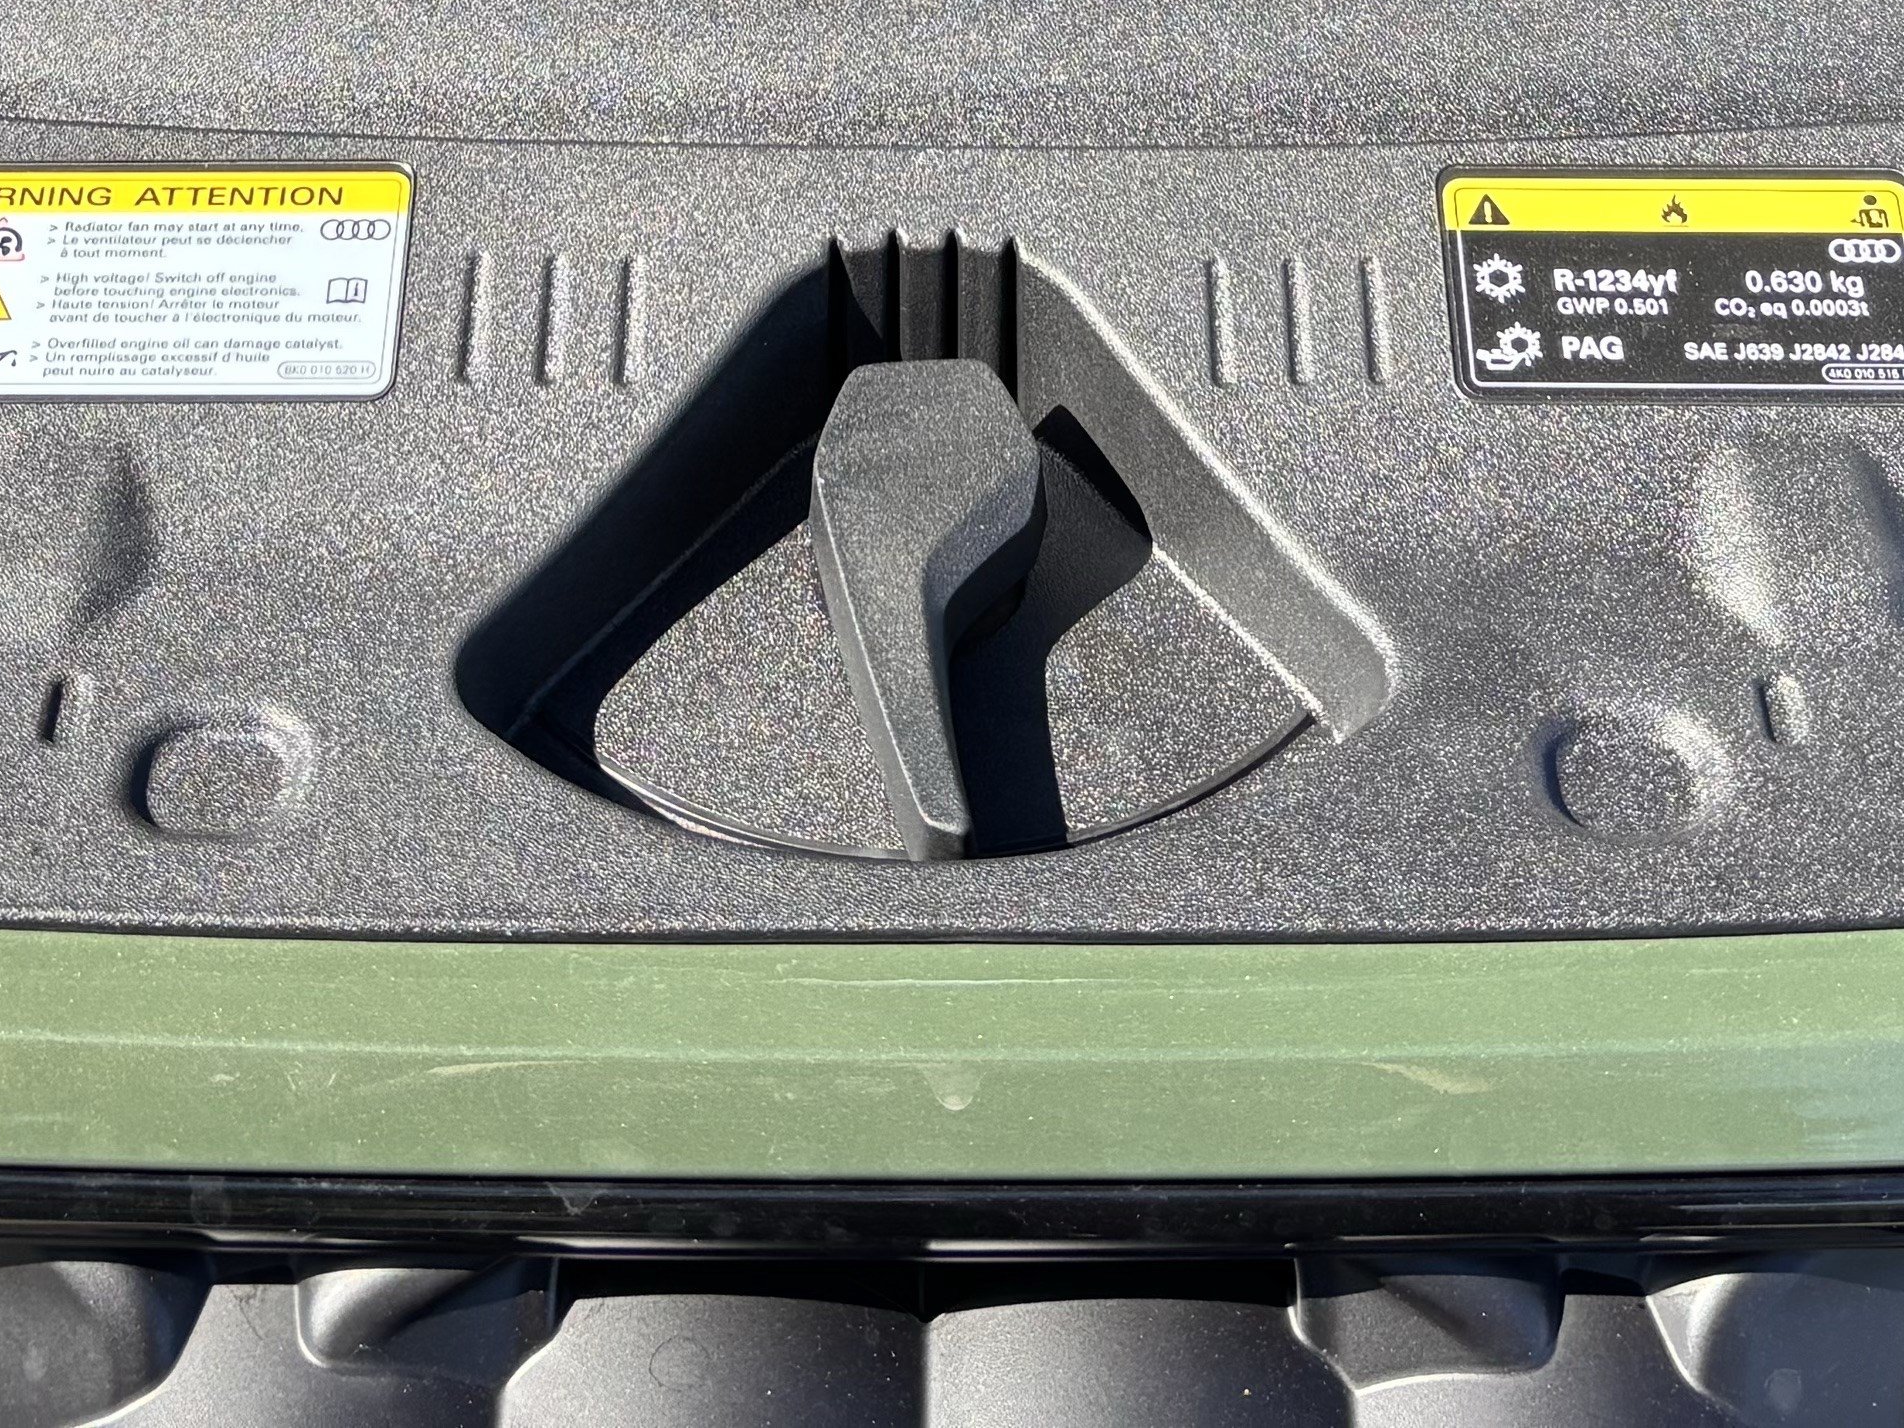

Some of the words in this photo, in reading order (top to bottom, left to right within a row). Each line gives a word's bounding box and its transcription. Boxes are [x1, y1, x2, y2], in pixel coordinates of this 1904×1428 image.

[134, 186, 344, 207] ATTENTION
[65, 222, 123, 232] Radiator
[128, 222, 149, 232] fan
[154, 223, 184, 234] may
[188, 222, 219, 233] start
[222, 223, 236, 233] at
[240, 224, 265, 234] any
[62, 234, 79, 245] Le
[84, 234, 157, 245] ventilateur
[162, 236, 192, 247] peut
[196, 237, 212, 246] se
[73, 248, 100, 258] tout
[56, 272, 88, 286] High
[154, 272, 202, 283] Switch
[206, 272, 226, 283] off
[229, 273, 277, 286] engine
[1553, 268, 1678, 297] R-1234yf
[1745, 270, 1823, 294] 0.630
[1830, 270, 1865, 298] kg
[54, 285, 99, 297] before
[104, 287, 165, 298] touching
[170, 287, 217, 299] engine
[52, 299, 93, 310] Haute
[212, 298, 224, 309] le
[228, 300, 280, 309] moteur
[1557, 298, 1610, 316] GWP
[1614, 298, 1669, 316] 0.501
[1760, 302, 1788, 319] eq
[1792, 298, 1870, 317] 0.0003t
[49, 313, 88, 323] avant
[92, 312, 109, 323] de
[114, 312, 167, 323] toucher
[285, 312, 303, 323] du
[48, 338, 117, 350] Overfilled
[120, 338, 169, 351] engine
[172, 338, 190, 349] oil
[194, 340, 219, 349] can
[224, 338, 281, 351] damage
[1561, 336, 1625, 361] PAG
[1684, 342, 1729, 361] SAE
[1734, 342, 1785, 361] J639
[1789, 342, 1852, 361] J2842
[46, 352, 66, 363] Un
[70, 352, 157, 364] remplissage
[161, 352, 219, 363] excessif
[42, 366, 74, 378] peut
[79, 366, 115, 376] nuire
[120, 368, 136, 376] au
